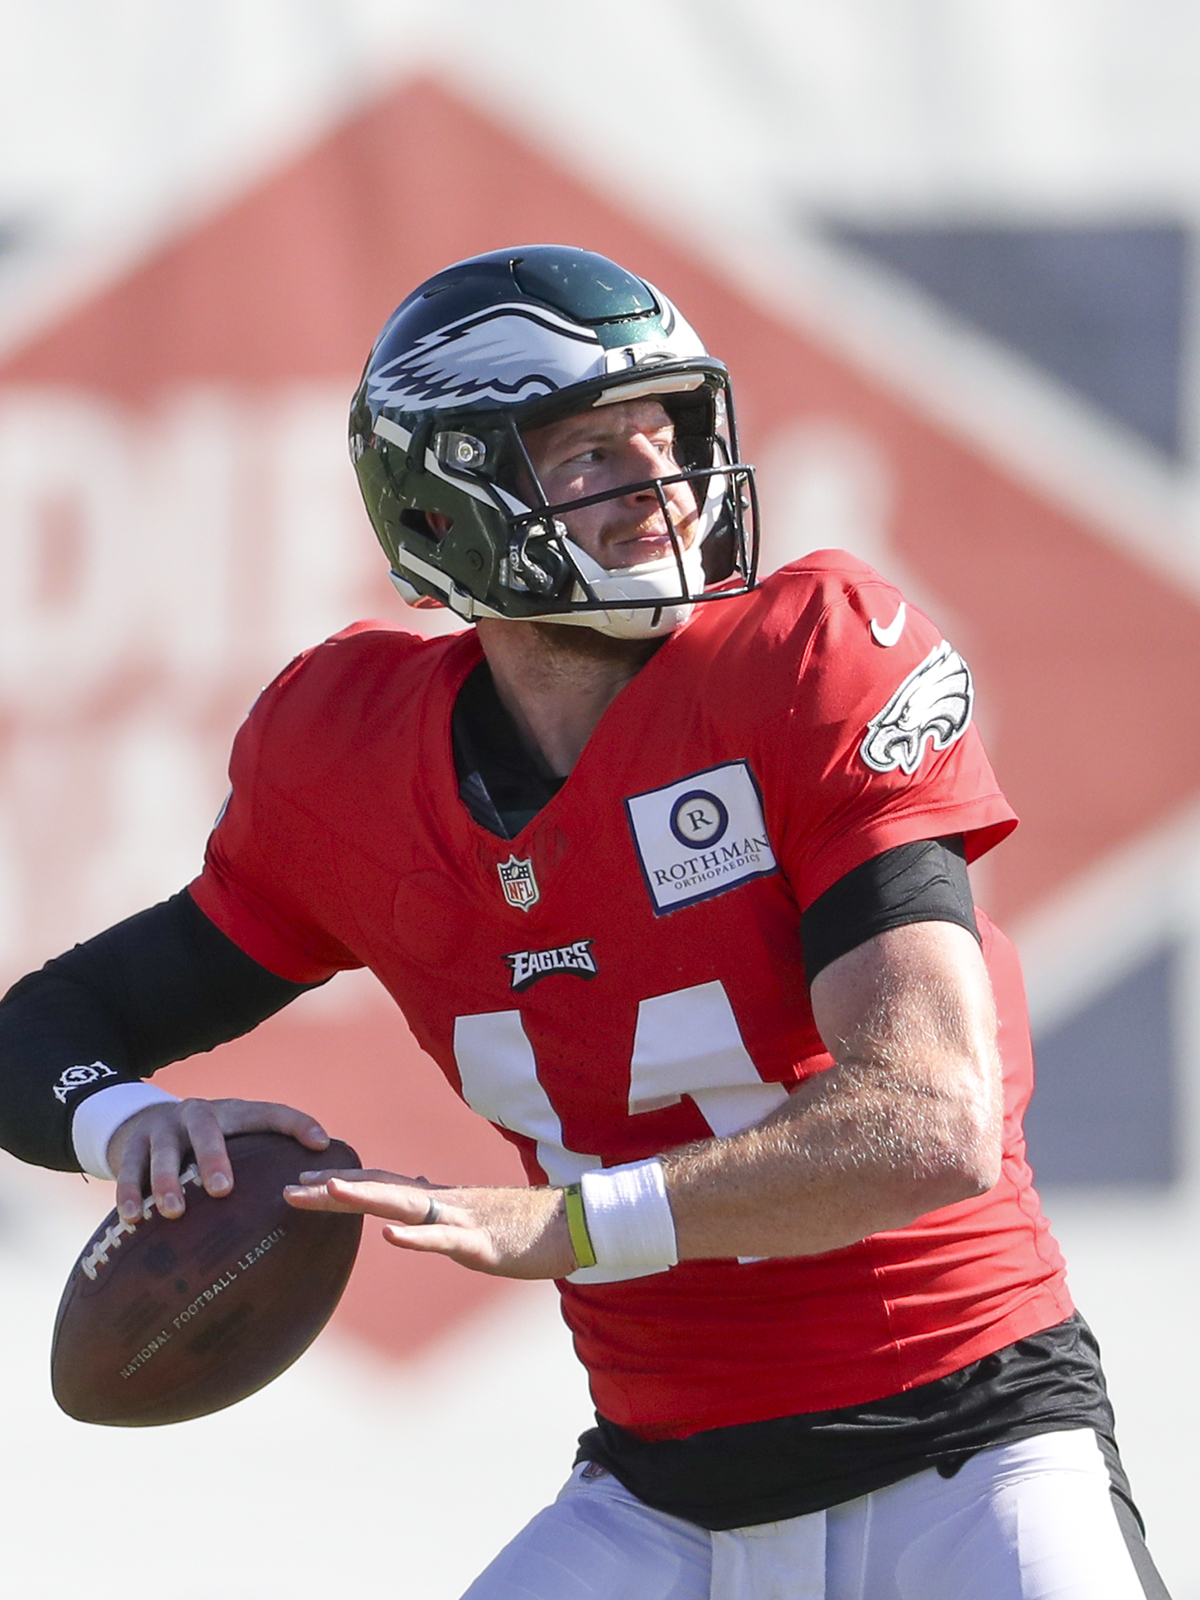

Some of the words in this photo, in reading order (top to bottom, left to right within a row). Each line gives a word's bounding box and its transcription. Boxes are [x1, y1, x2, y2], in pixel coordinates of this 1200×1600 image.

[686, 809, 714, 833] R
[653, 833, 771, 887] ROTHMAN
[506, 880, 534, 901] NFL
[505, 940, 597, 988] EAGLES
[119, 1329, 173, 1380] NATIONAL
[172, 1270, 238, 1330] FOOTBALL
[237, 1226, 287, 1271] LEAGUE
